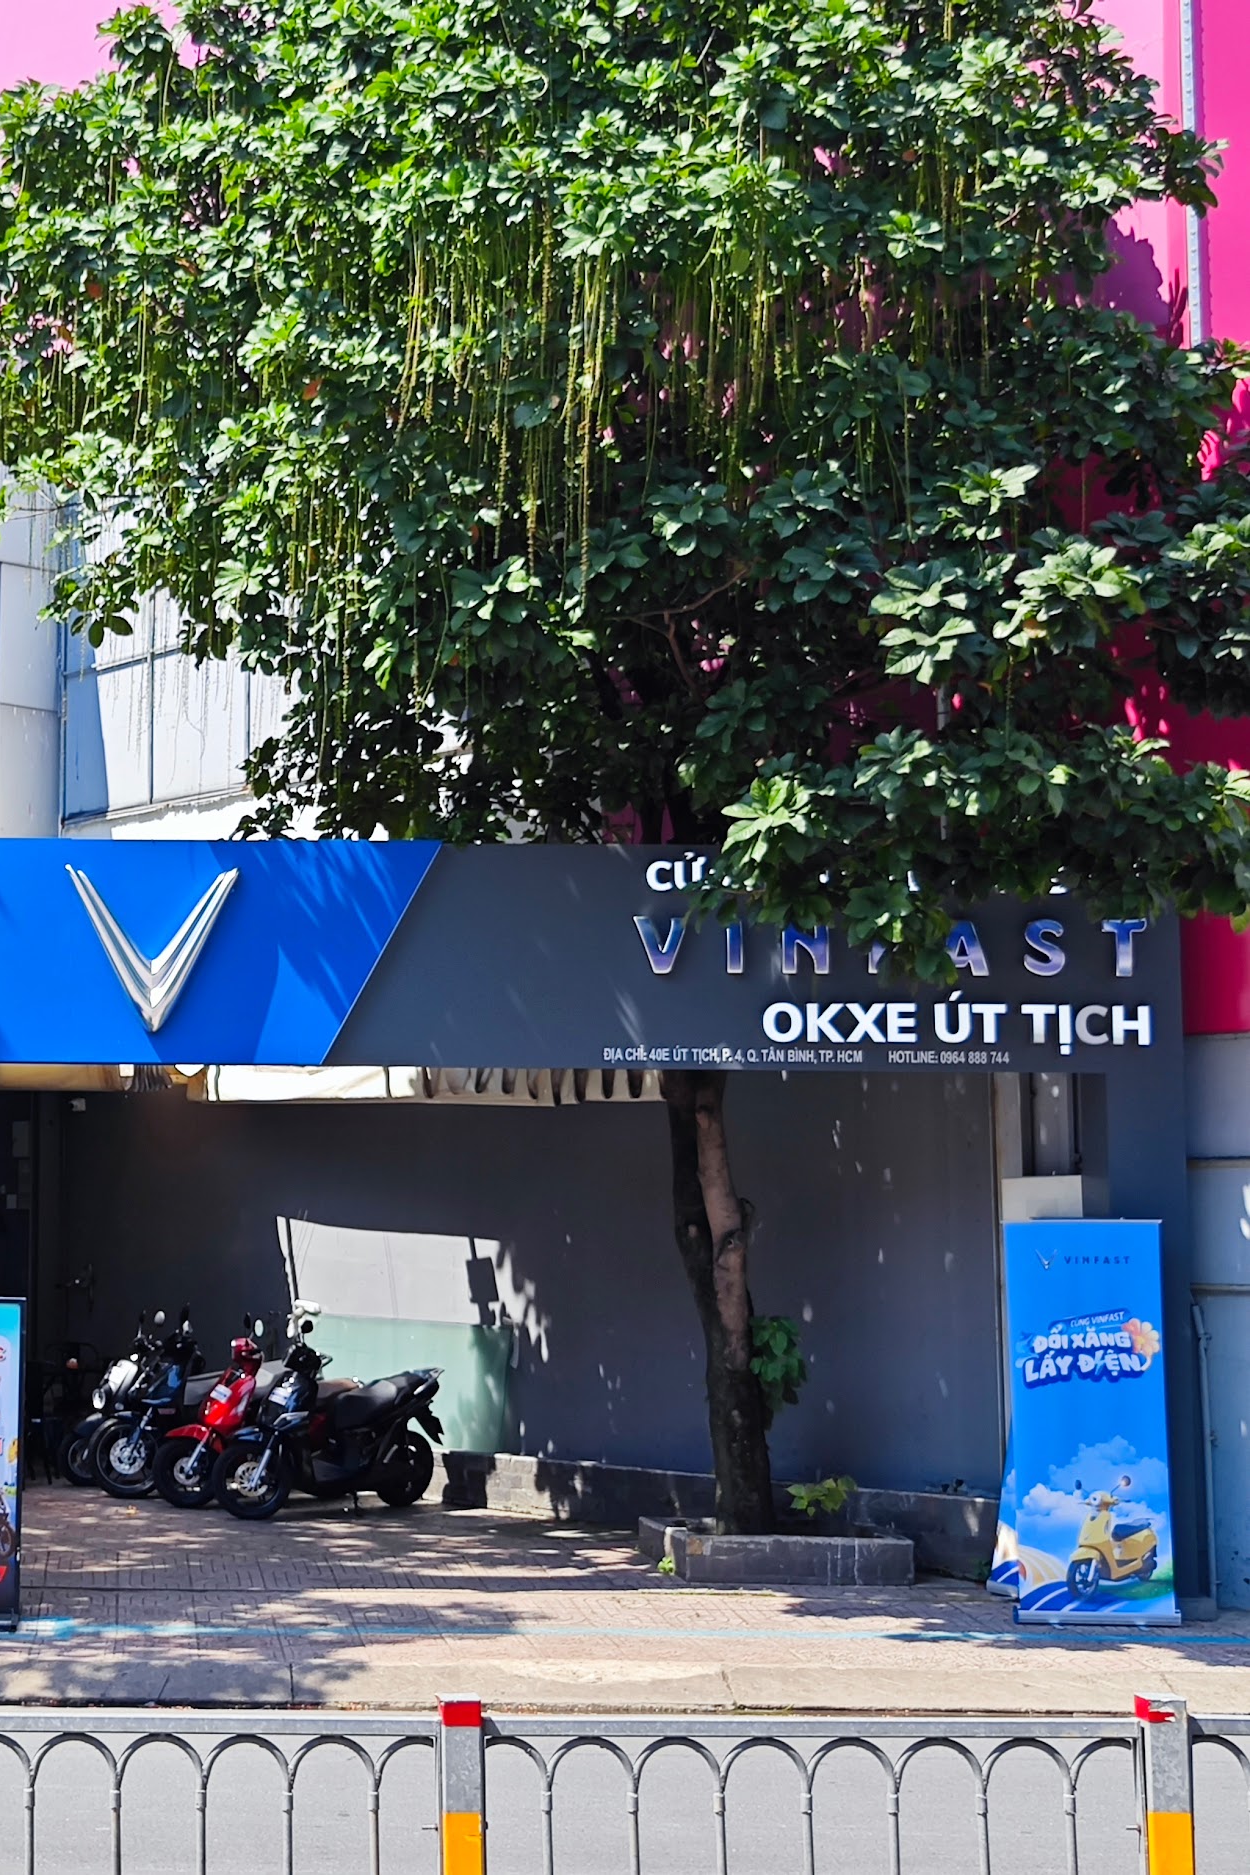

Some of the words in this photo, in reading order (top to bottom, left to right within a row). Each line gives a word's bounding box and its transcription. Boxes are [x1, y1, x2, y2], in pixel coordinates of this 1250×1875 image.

[645, 851, 733, 892] CỬ
[632, 914, 1148, 978] VINAST
[762, 1001, 918, 1044] OKXE
[933, 990, 1008, 1045] ÚT
[1021, 1004, 1152, 1056] TỊCH
[603, 1048, 624, 1064] ĐỊA
[648, 1047, 670, 1061] 40E
[672, 1045, 689, 1061] ÚT
[691, 1047, 721, 1064] TỊCH,
[722, 1048, 733, 1062] P.
[734, 1048, 745, 1063] 4,
[747, 1049, 759, 1063] Q.
[761, 1046, 785, 1062] TÂN
[787, 1047, 817, 1064] BÌNH,
[819, 1050, 835, 1063] TP.
[837, 1050, 863, 1063] HCM
[888, 1050, 939, 1064] HOTLINE:
[940, 1051, 965, 1064] 0964
[968, 1052, 987, 1064] 888
[990, 1052, 1010, 1065] 744
[1063, 1255, 1130, 1265] VINFAST
[1091, 1311, 1125, 1325] VINFAST
[1033, 1324, 1069, 1354] ĐỔI
[1071, 1326, 1132, 1350] XĂNG
[1024, 1351, 1074, 1383] LẤY
[1077, 1349, 1142, 1377] ĐIỆN
